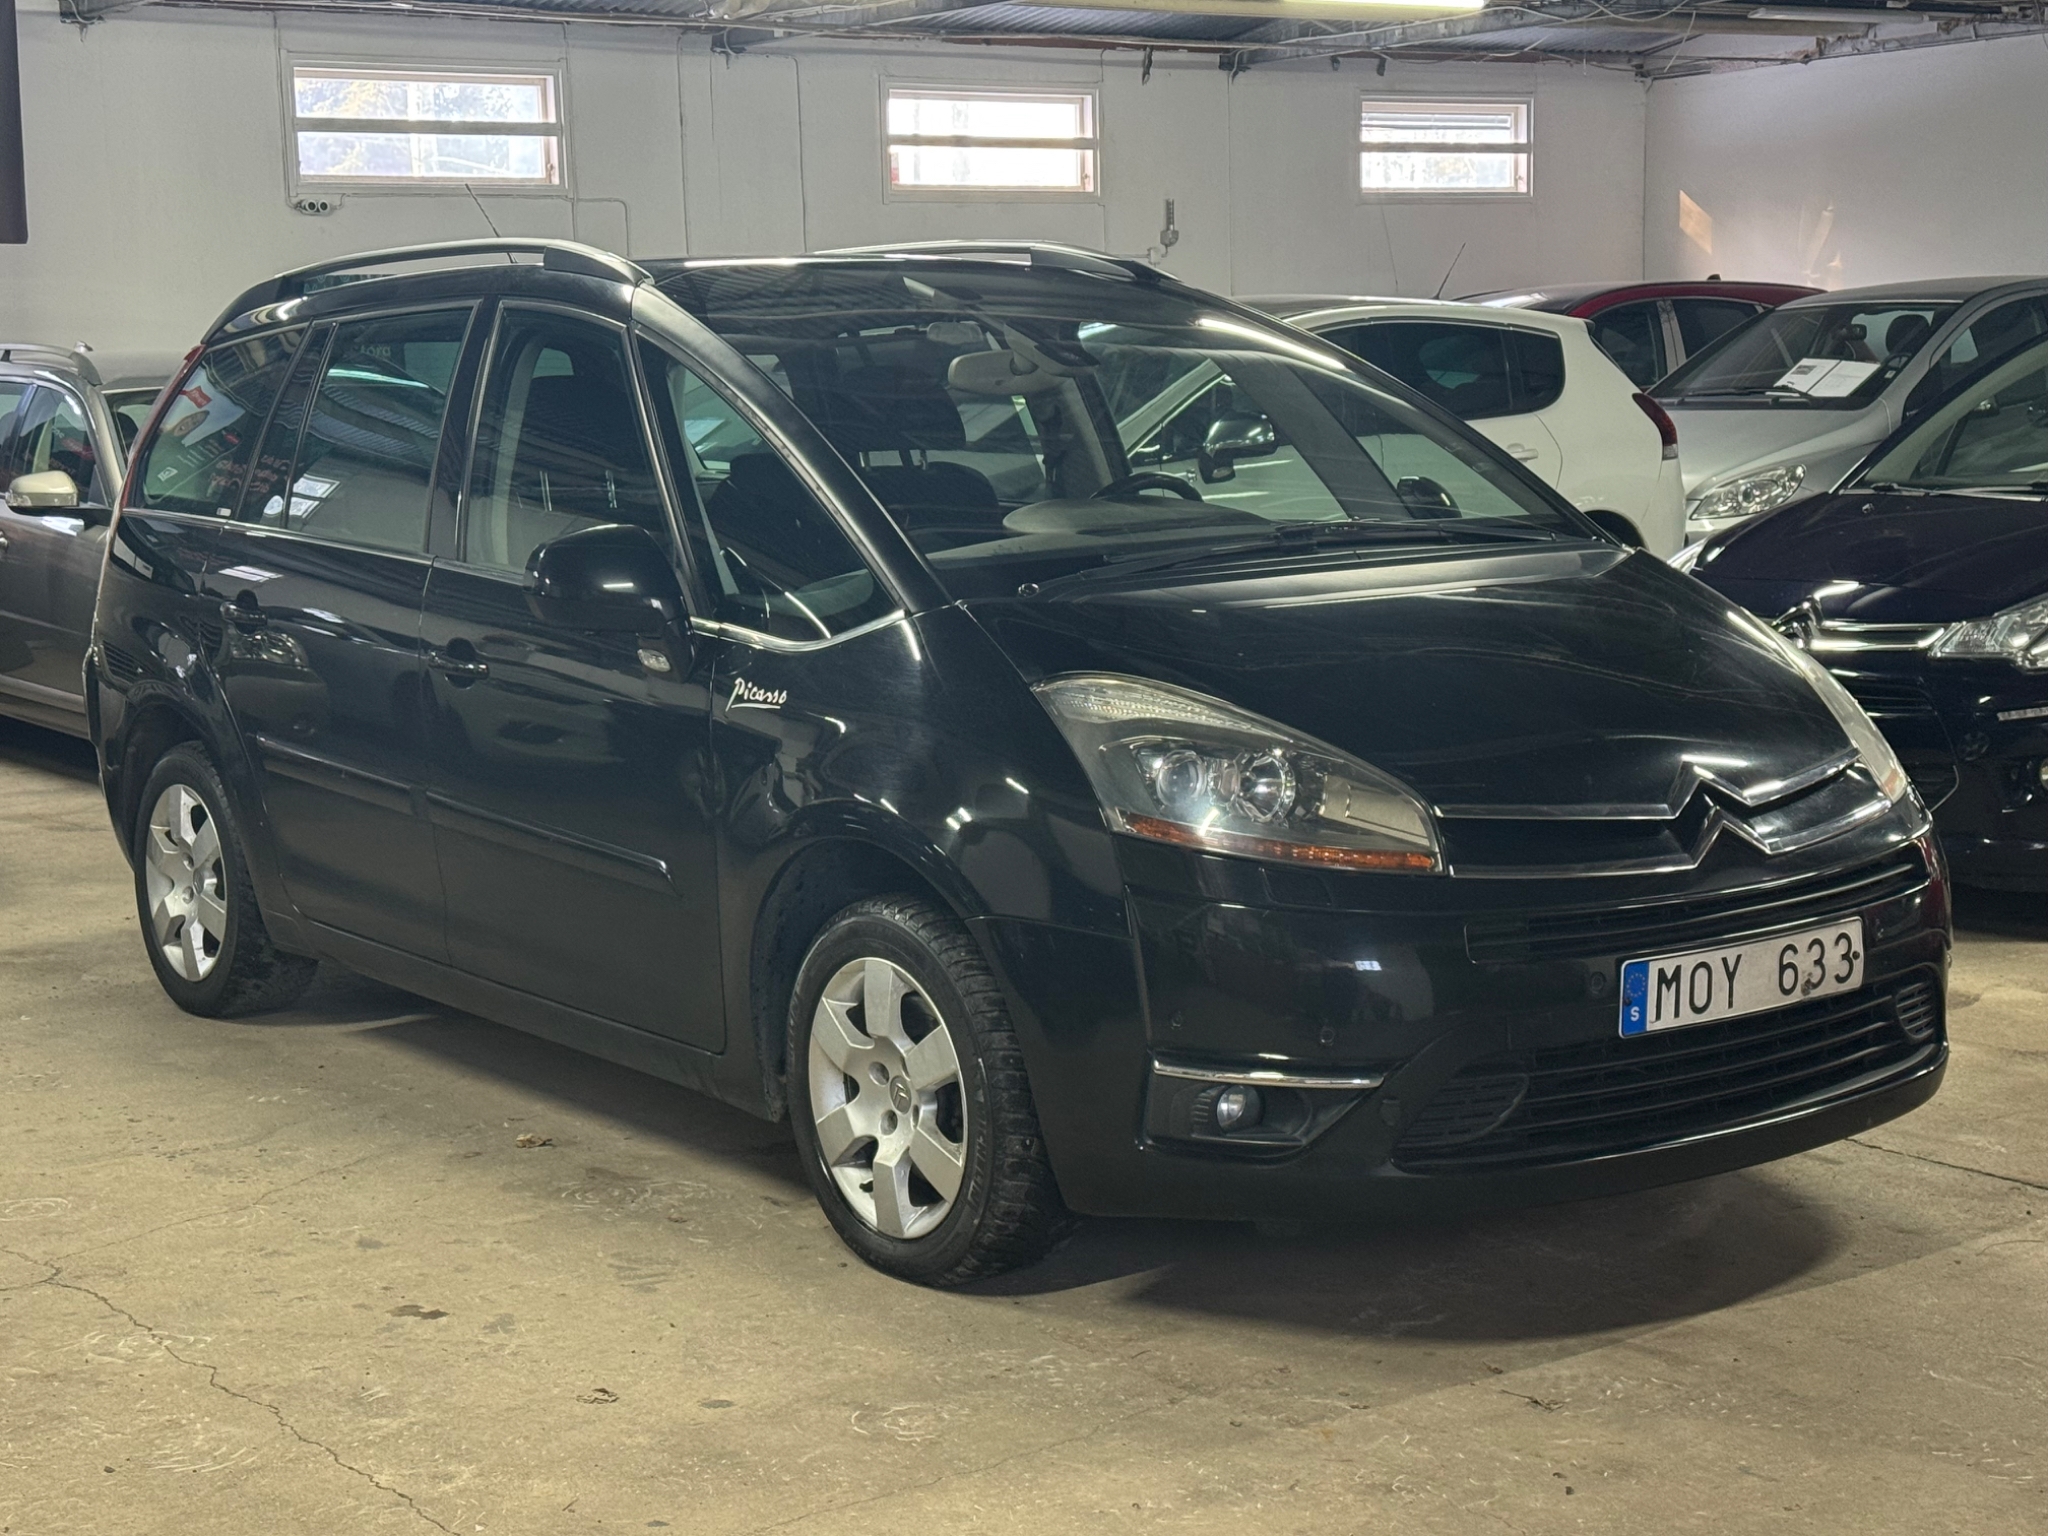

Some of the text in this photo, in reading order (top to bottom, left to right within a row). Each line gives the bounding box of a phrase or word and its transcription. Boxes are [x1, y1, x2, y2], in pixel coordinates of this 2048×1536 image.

[725, 677, 787, 712] Picasso
[1654, 932, 1855, 1022] MOY 633
[1630, 1006, 1640, 1021] S
